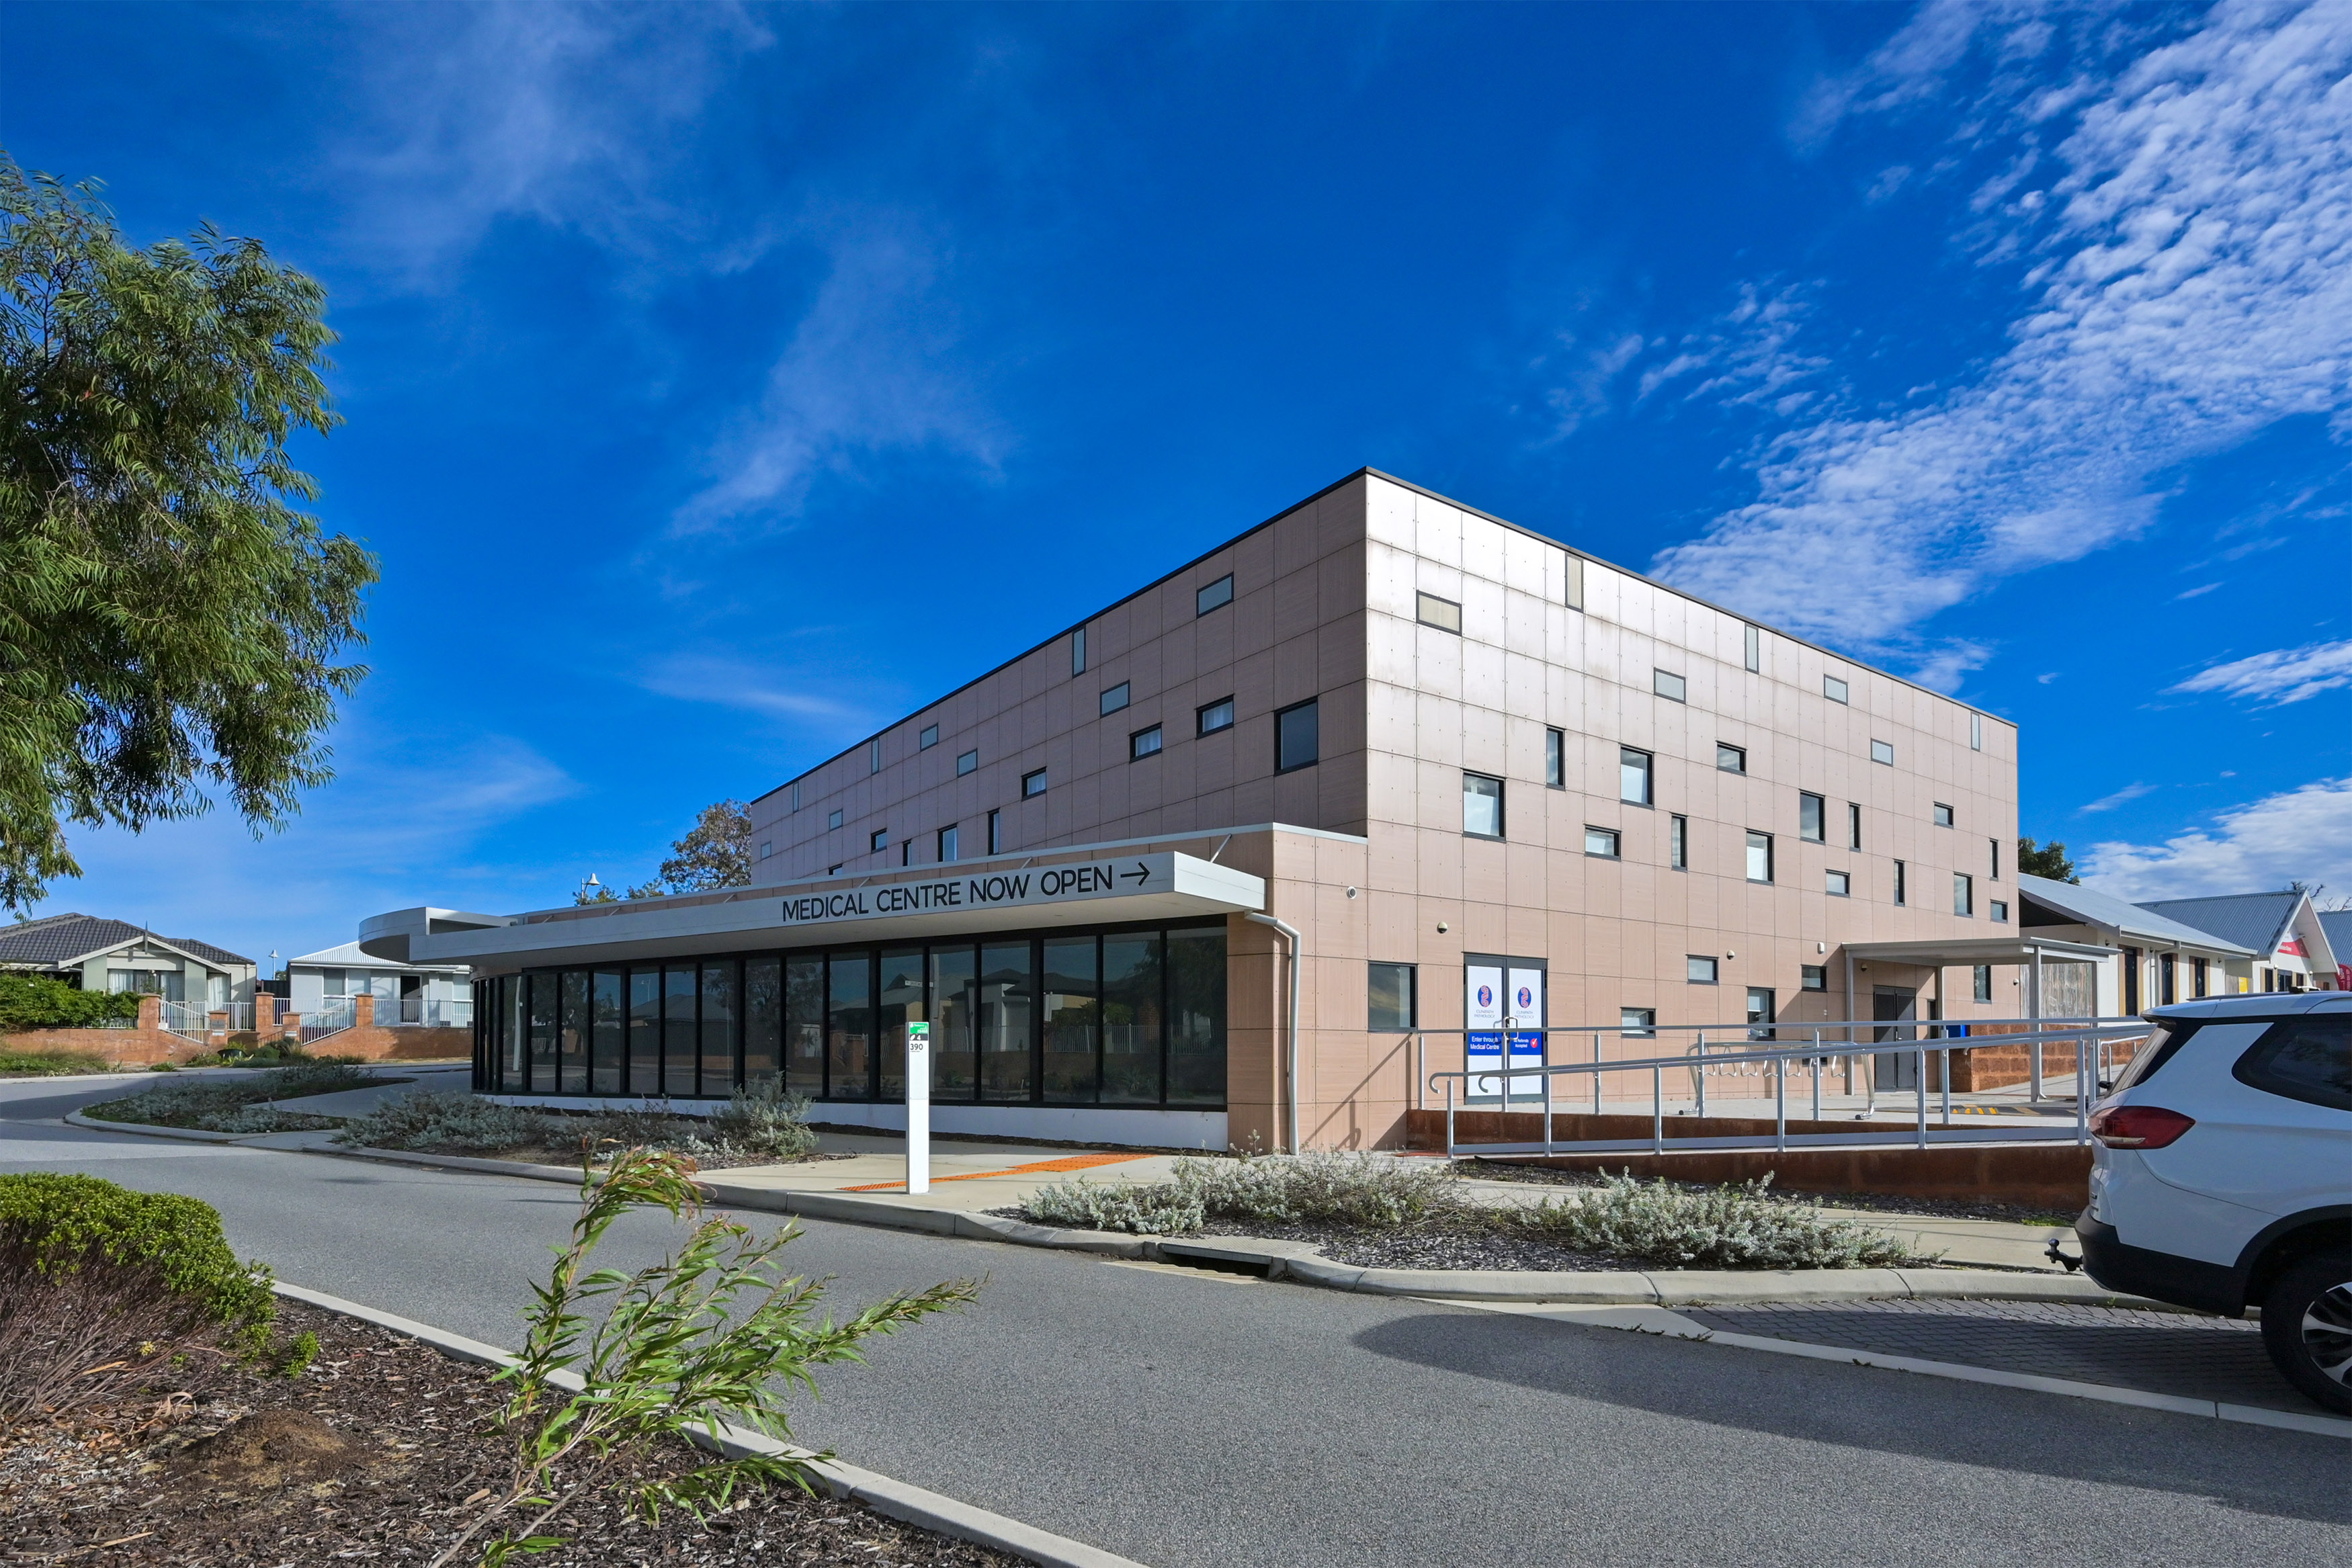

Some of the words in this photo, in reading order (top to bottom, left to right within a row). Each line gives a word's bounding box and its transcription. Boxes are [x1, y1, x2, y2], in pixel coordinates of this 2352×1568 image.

[783, 893, 869, 922] MEDICAL
[876, 881, 961, 912] CENTRE
[970, 874, 1030, 903] NOW
[1040, 865, 1112, 896] OPEN
